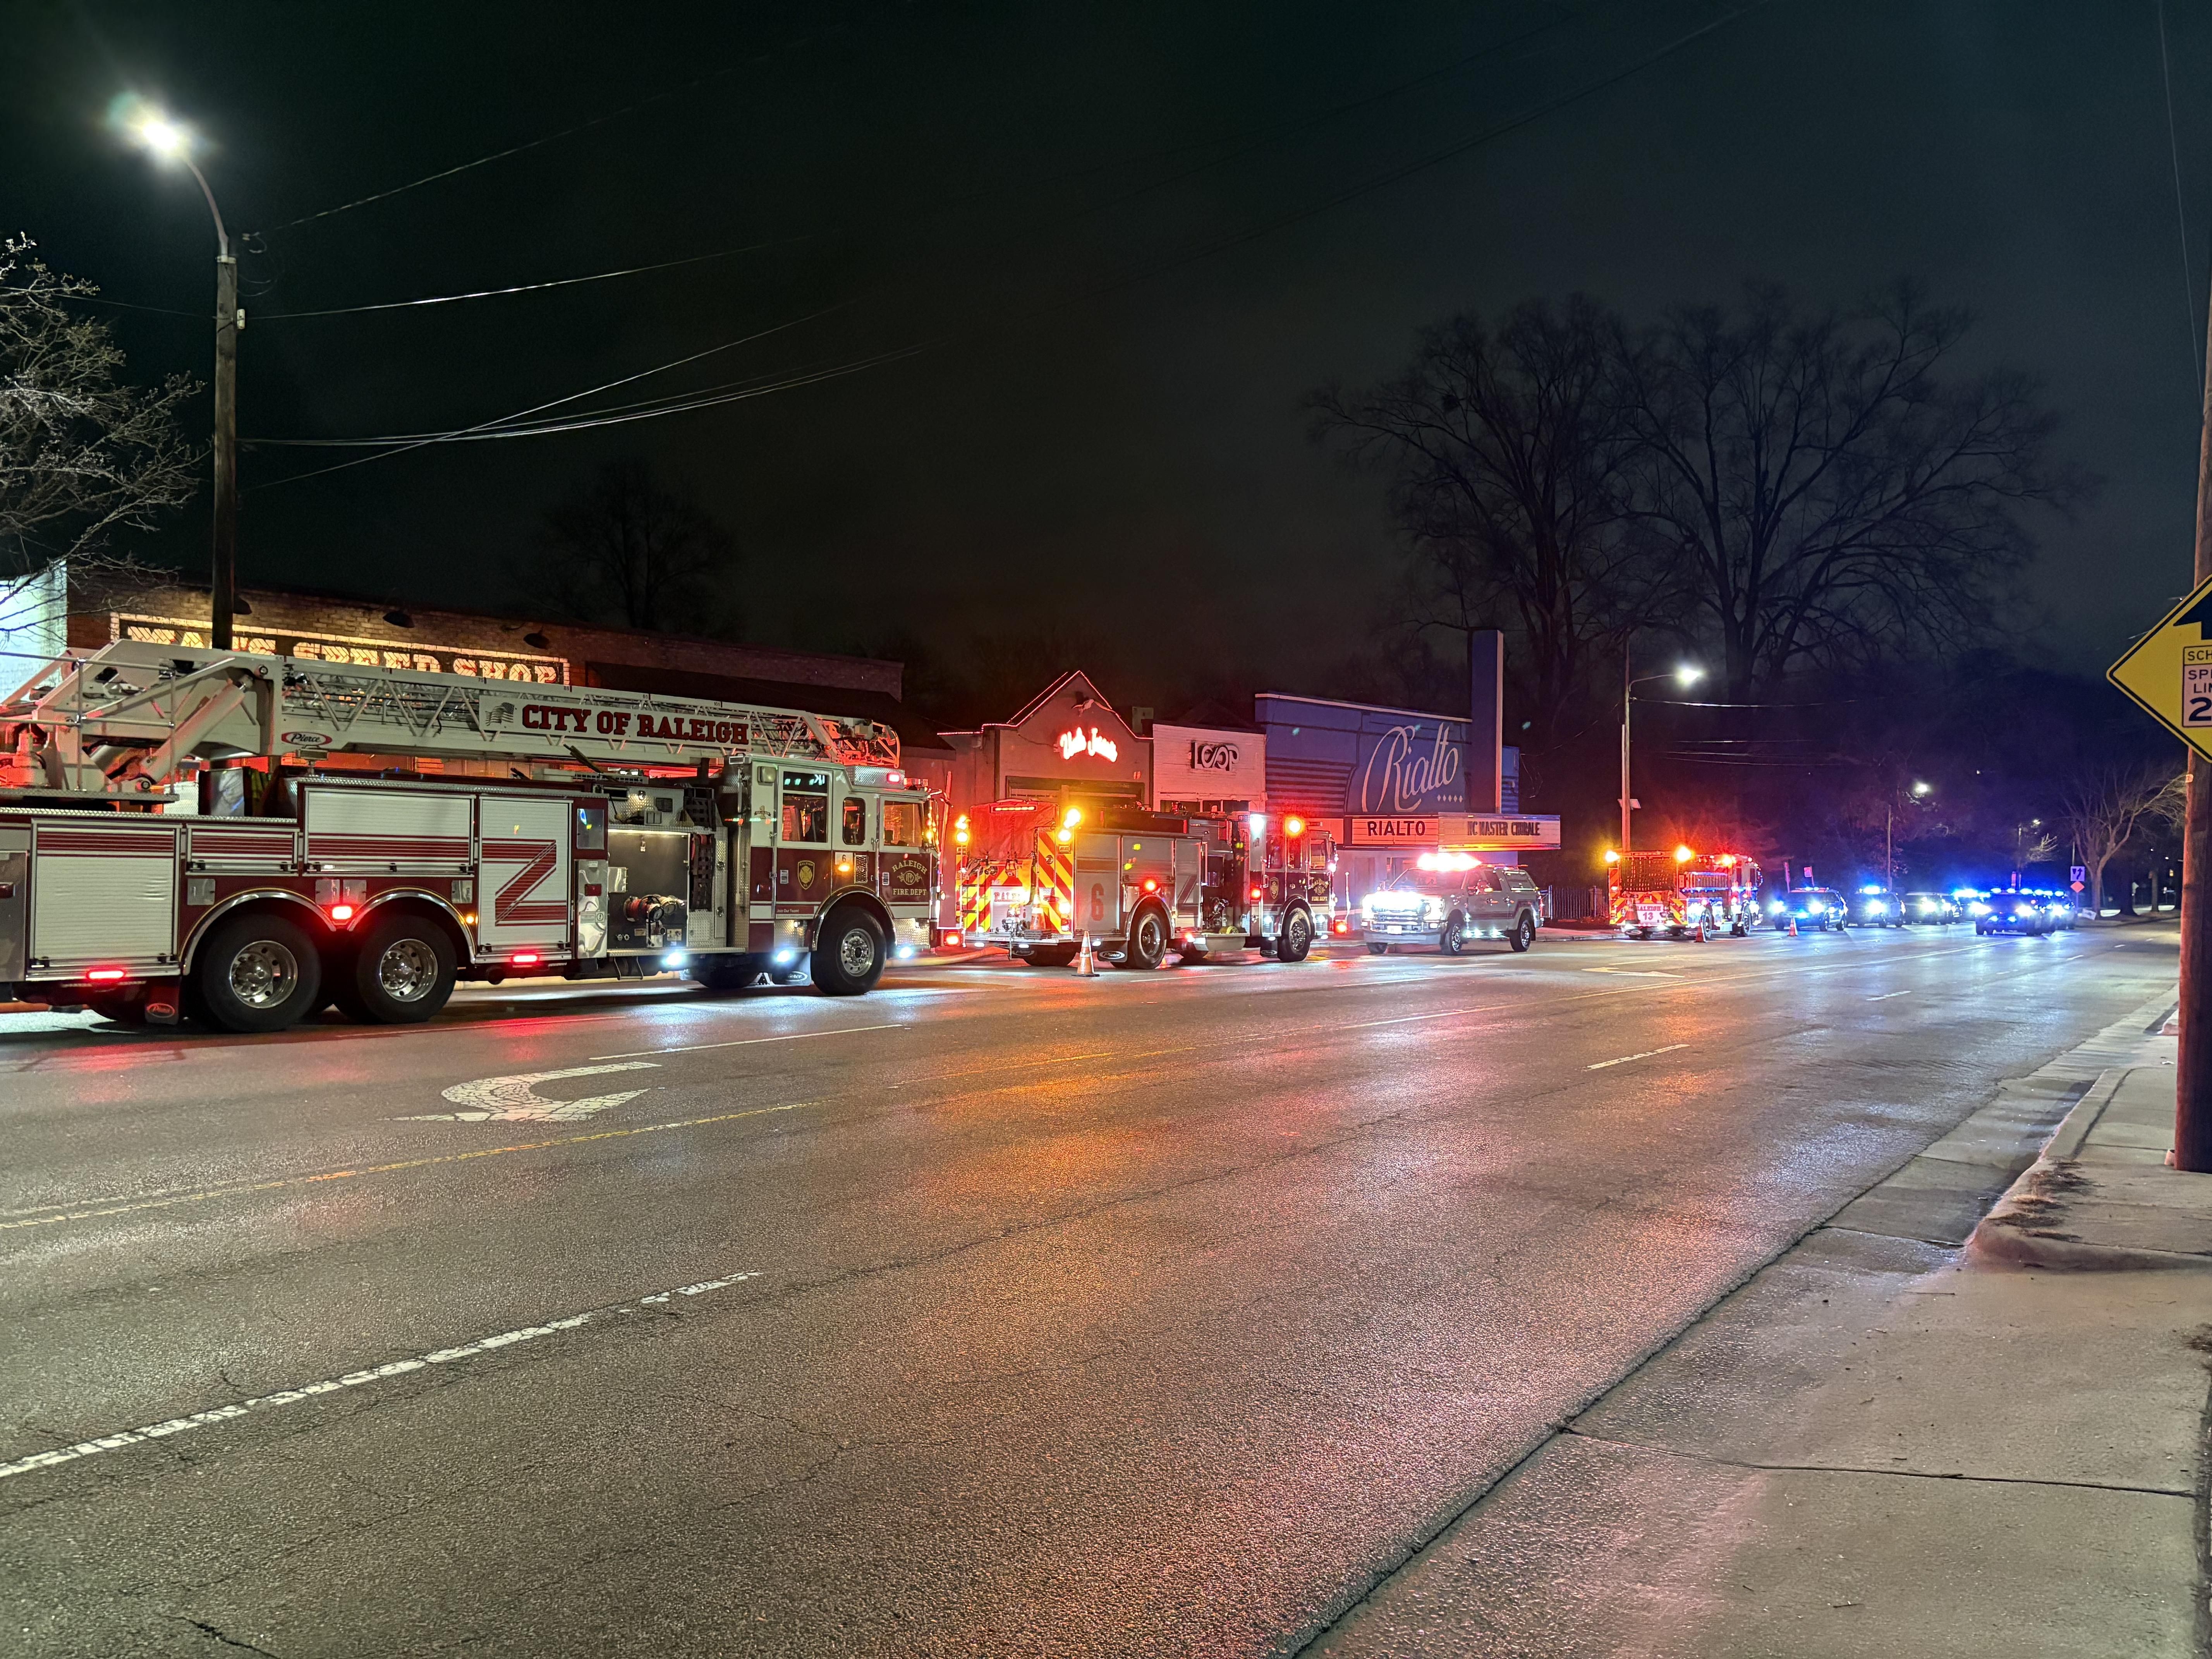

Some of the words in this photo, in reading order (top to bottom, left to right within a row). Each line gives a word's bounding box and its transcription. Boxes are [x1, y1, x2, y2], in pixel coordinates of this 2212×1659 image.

[293, 642, 441, 673] SPEED
[453, 658, 556, 684] SHOP
[2188, 669, 2212, 680] SP
[522, 704, 591, 732] CITY
[597, 711, 631, 735] OF
[637, 714, 749, 744] RALEIGH
[291, 733, 320, 742] Pierce
[1192, 742, 1239, 771] LOOP
[1361, 722, 1458, 812] Rialto
[1367, 820, 1426, 836] RIALTO
[1467, 821, 1478, 836] NC
[1479, 821, 1508, 836] MASTER
[892, 860, 927, 875] RALEIGH
[1091, 883, 1104, 921] 6
[1643, 912, 1654, 921] 13
